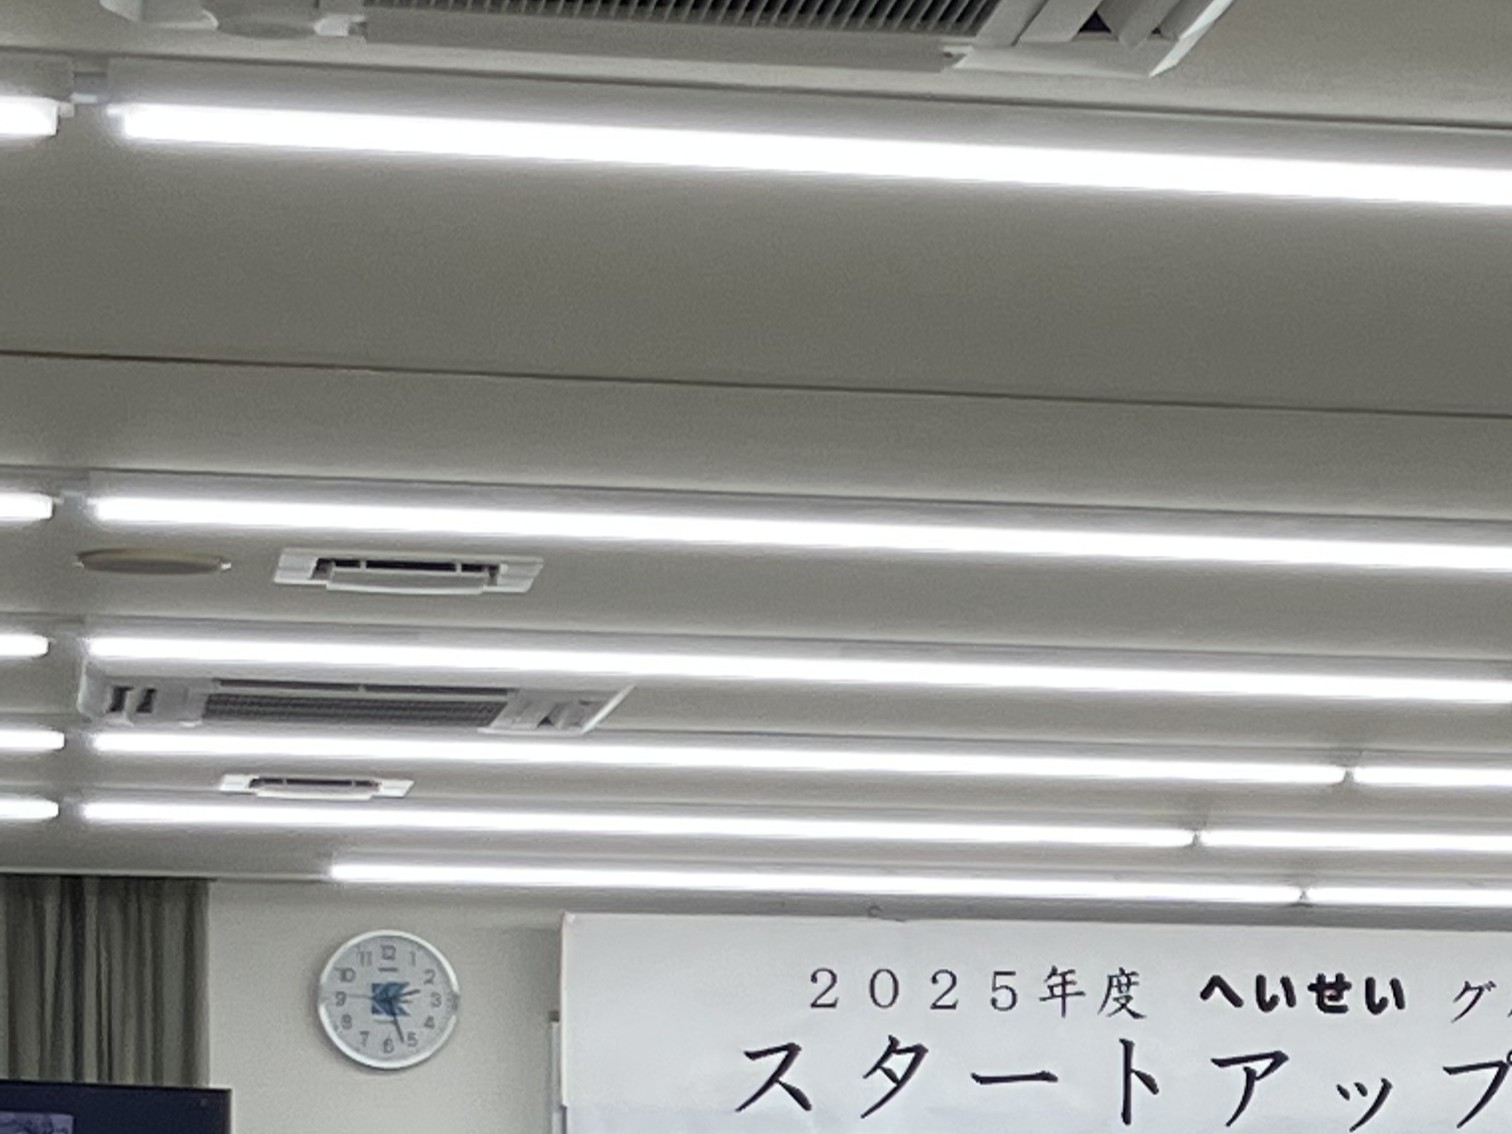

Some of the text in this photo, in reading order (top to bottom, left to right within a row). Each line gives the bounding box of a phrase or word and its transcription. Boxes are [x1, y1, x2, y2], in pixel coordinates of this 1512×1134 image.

[356, 951, 373, 967] 11
[423, 968, 436, 985] 2
[335, 991, 347, 1007] 9
[430, 991, 442, 1008] 3
[809, 965, 1147, 1020] 2025年度
[1199, 973, 1406, 1016] へいせい
[359, 1030, 370, 1047] 7
[382, 1037, 395, 1054] 6
[406, 1031, 418, 1047] 5
